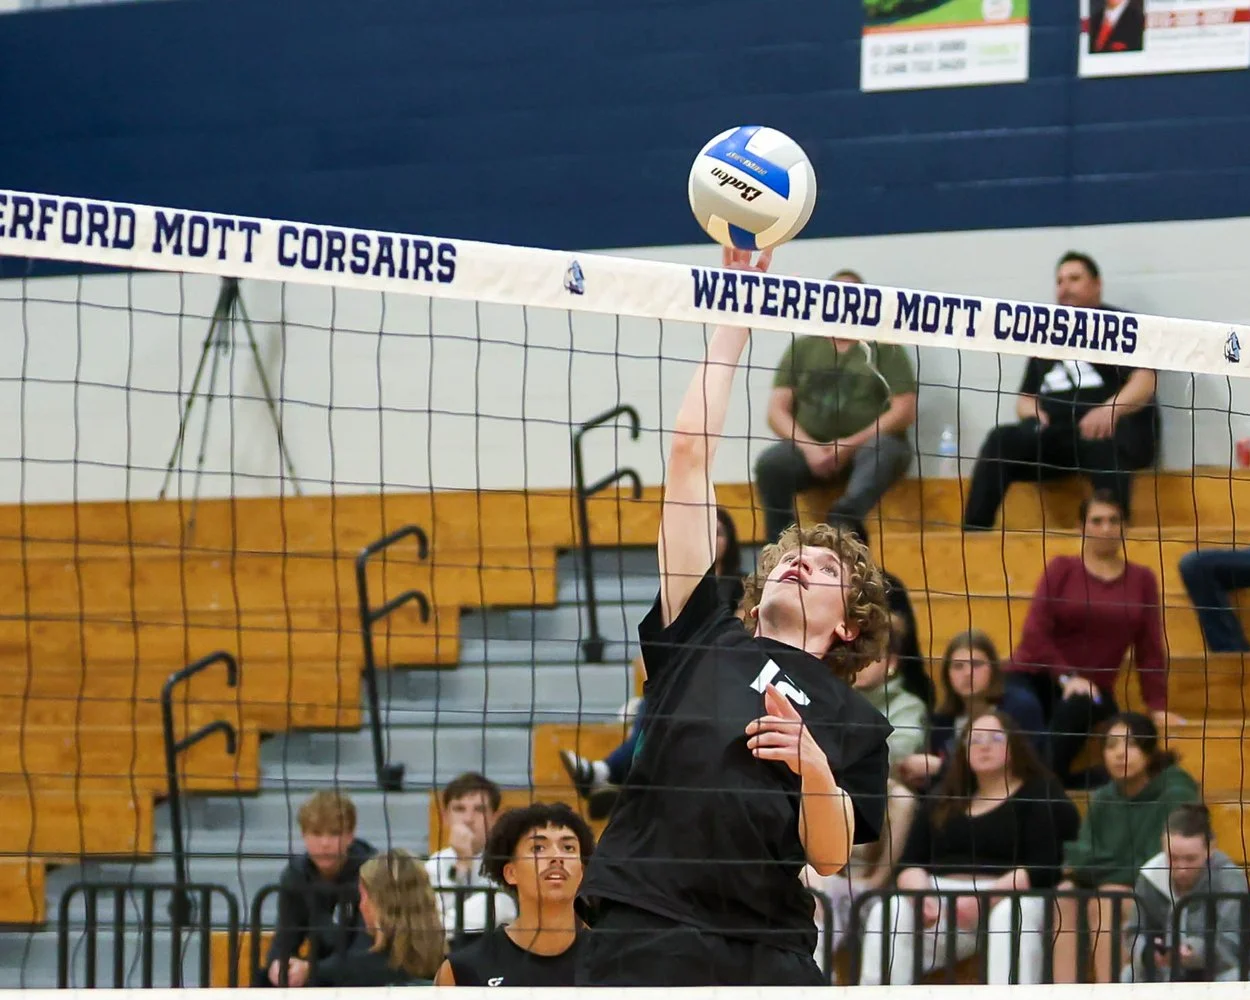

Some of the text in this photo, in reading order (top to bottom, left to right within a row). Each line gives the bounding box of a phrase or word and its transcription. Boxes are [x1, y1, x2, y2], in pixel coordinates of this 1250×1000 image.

[710, 167, 763, 202] Baden
[152, 211, 261, 263] MOTT
[277, 226, 457, 284] CORSAIRS
[691, 269, 1138, 354] WATERFORD MOTT CORSAIRS
